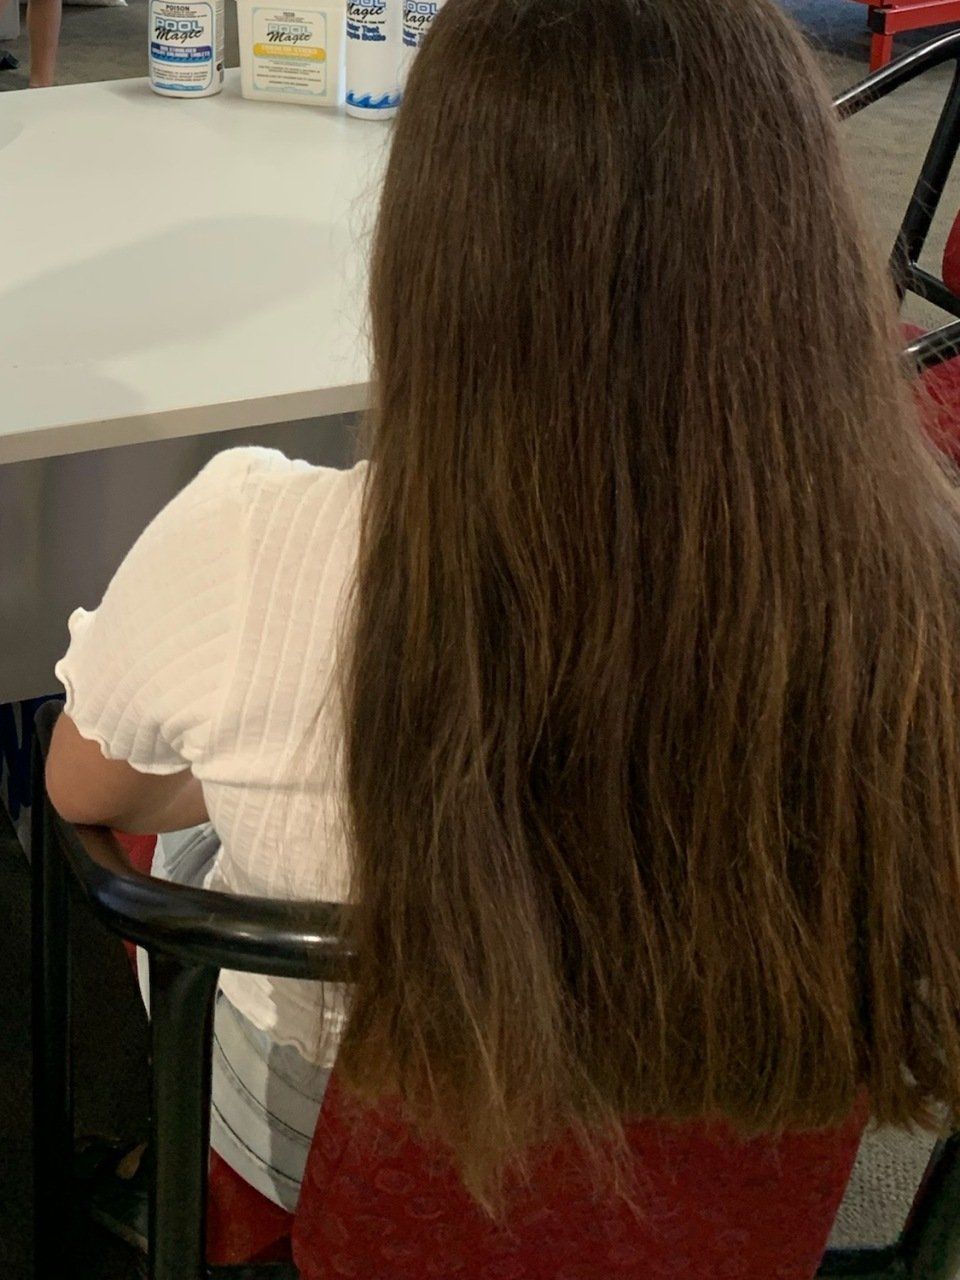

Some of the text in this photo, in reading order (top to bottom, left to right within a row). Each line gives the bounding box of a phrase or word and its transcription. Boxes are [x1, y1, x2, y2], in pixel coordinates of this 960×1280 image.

[166, 4, 190, 12] POISON
[404, 0, 438, 15] OOL
[155, 17, 203, 32] POOL
[403, 10, 433, 26] agi
[155, 27, 202, 43] Magic
[268, 23, 311, 35] POOL
[267, 31, 311, 44] Magic
